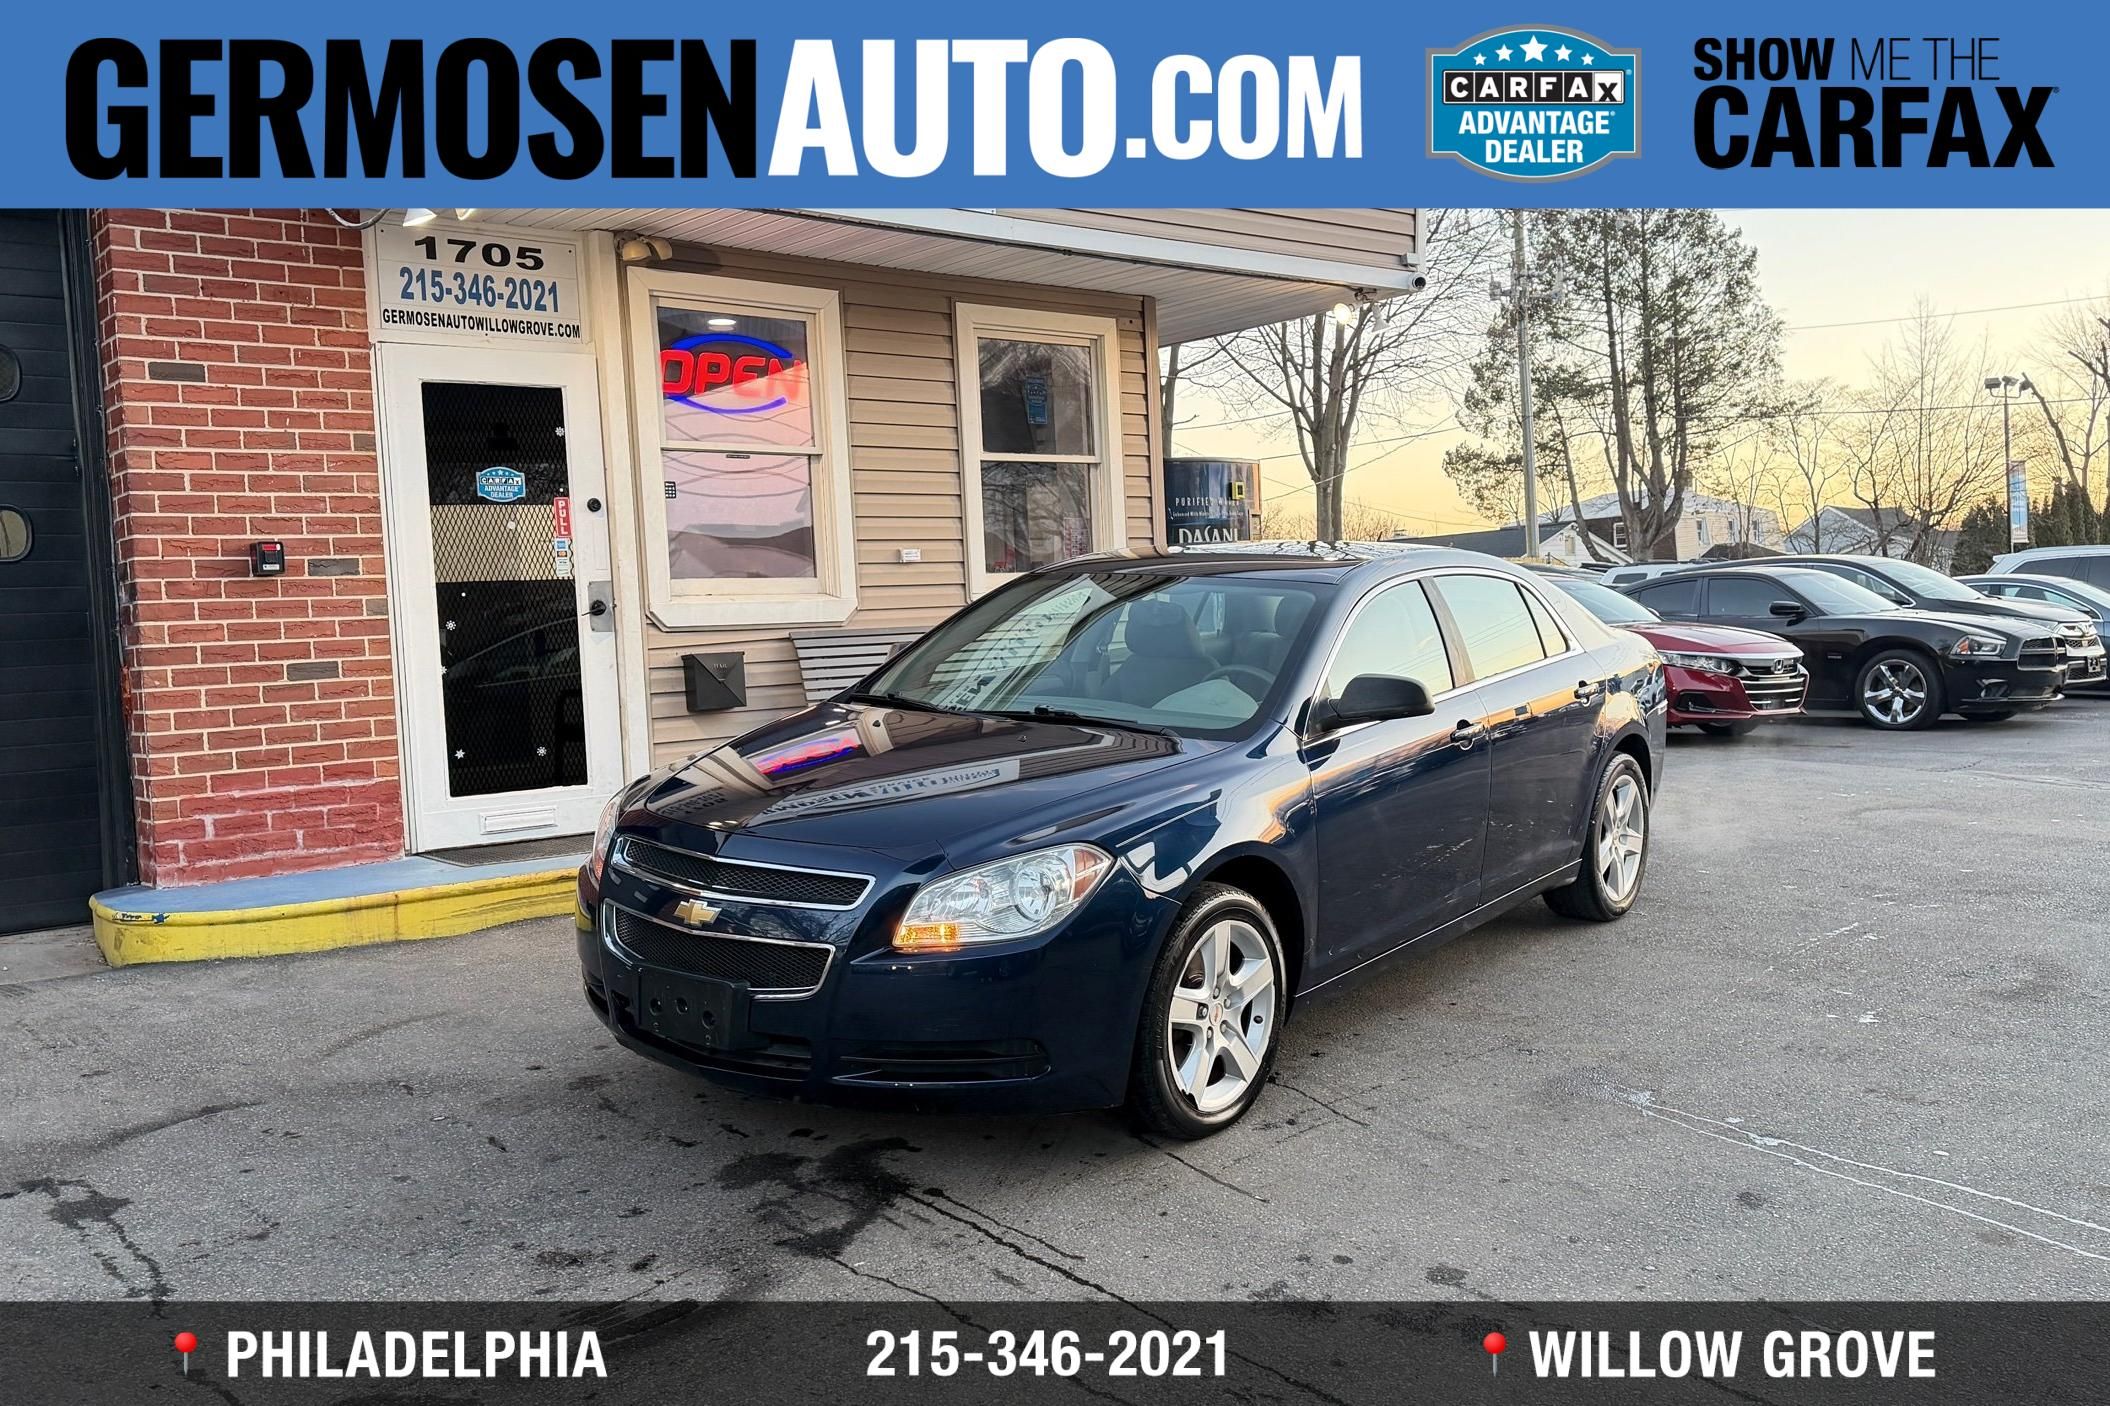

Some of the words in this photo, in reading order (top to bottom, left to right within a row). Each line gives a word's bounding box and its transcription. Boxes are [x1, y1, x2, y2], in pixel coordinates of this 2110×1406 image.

[414, 236, 545, 271] 1705
[399, 266, 560, 313] 215-346-2021
[382, 308, 581, 339] GERMOSENAUTOWILLOWGROVE.COM
[660, 349, 808, 400] OPEN
[481, 477, 521, 485] CARFAX
[557, 500, 569, 535] PULL
[1178, 525, 1239, 544] DASANI
